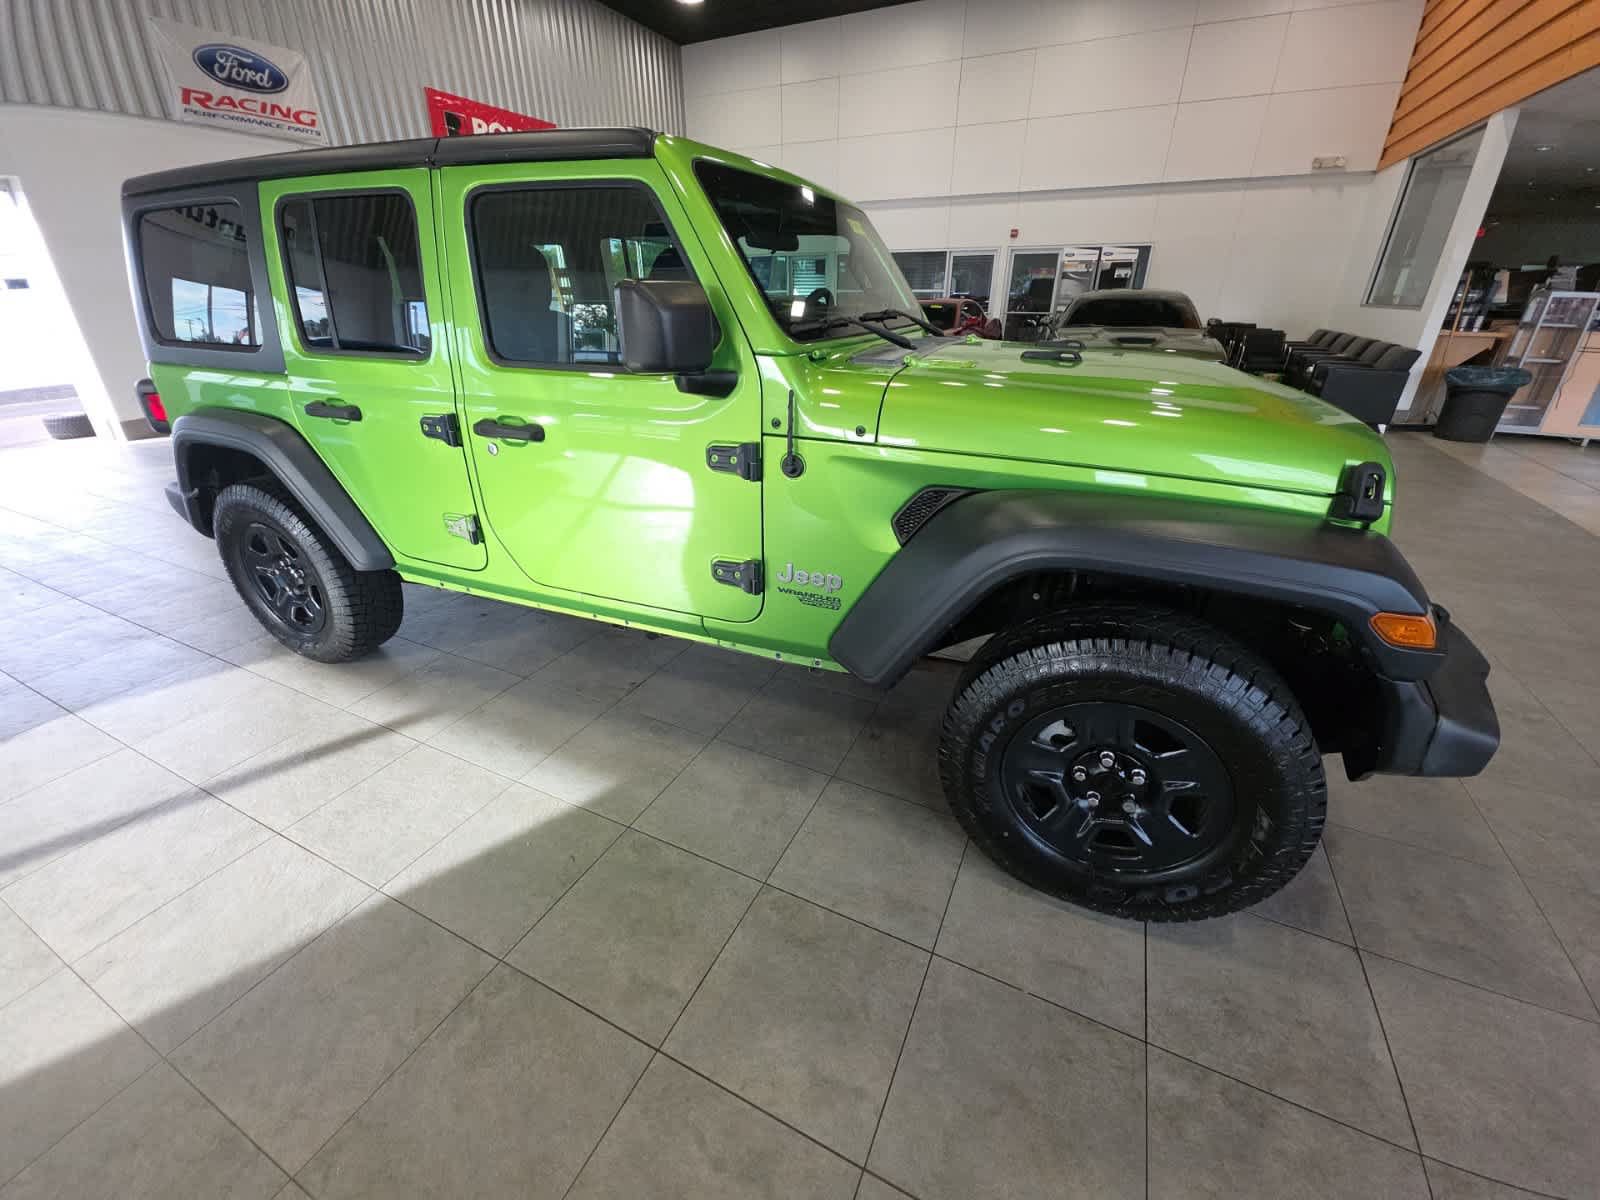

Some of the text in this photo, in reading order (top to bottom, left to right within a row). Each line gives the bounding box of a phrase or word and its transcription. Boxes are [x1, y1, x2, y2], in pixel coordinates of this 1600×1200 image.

[214, 50, 273, 88] Ford
[180, 86, 317, 129] RACING
[183, 107, 322, 137] PERFORMANCE PARTS
[776, 563, 843, 593] Jeep
[777, 586, 842, 603] WRANGLER
